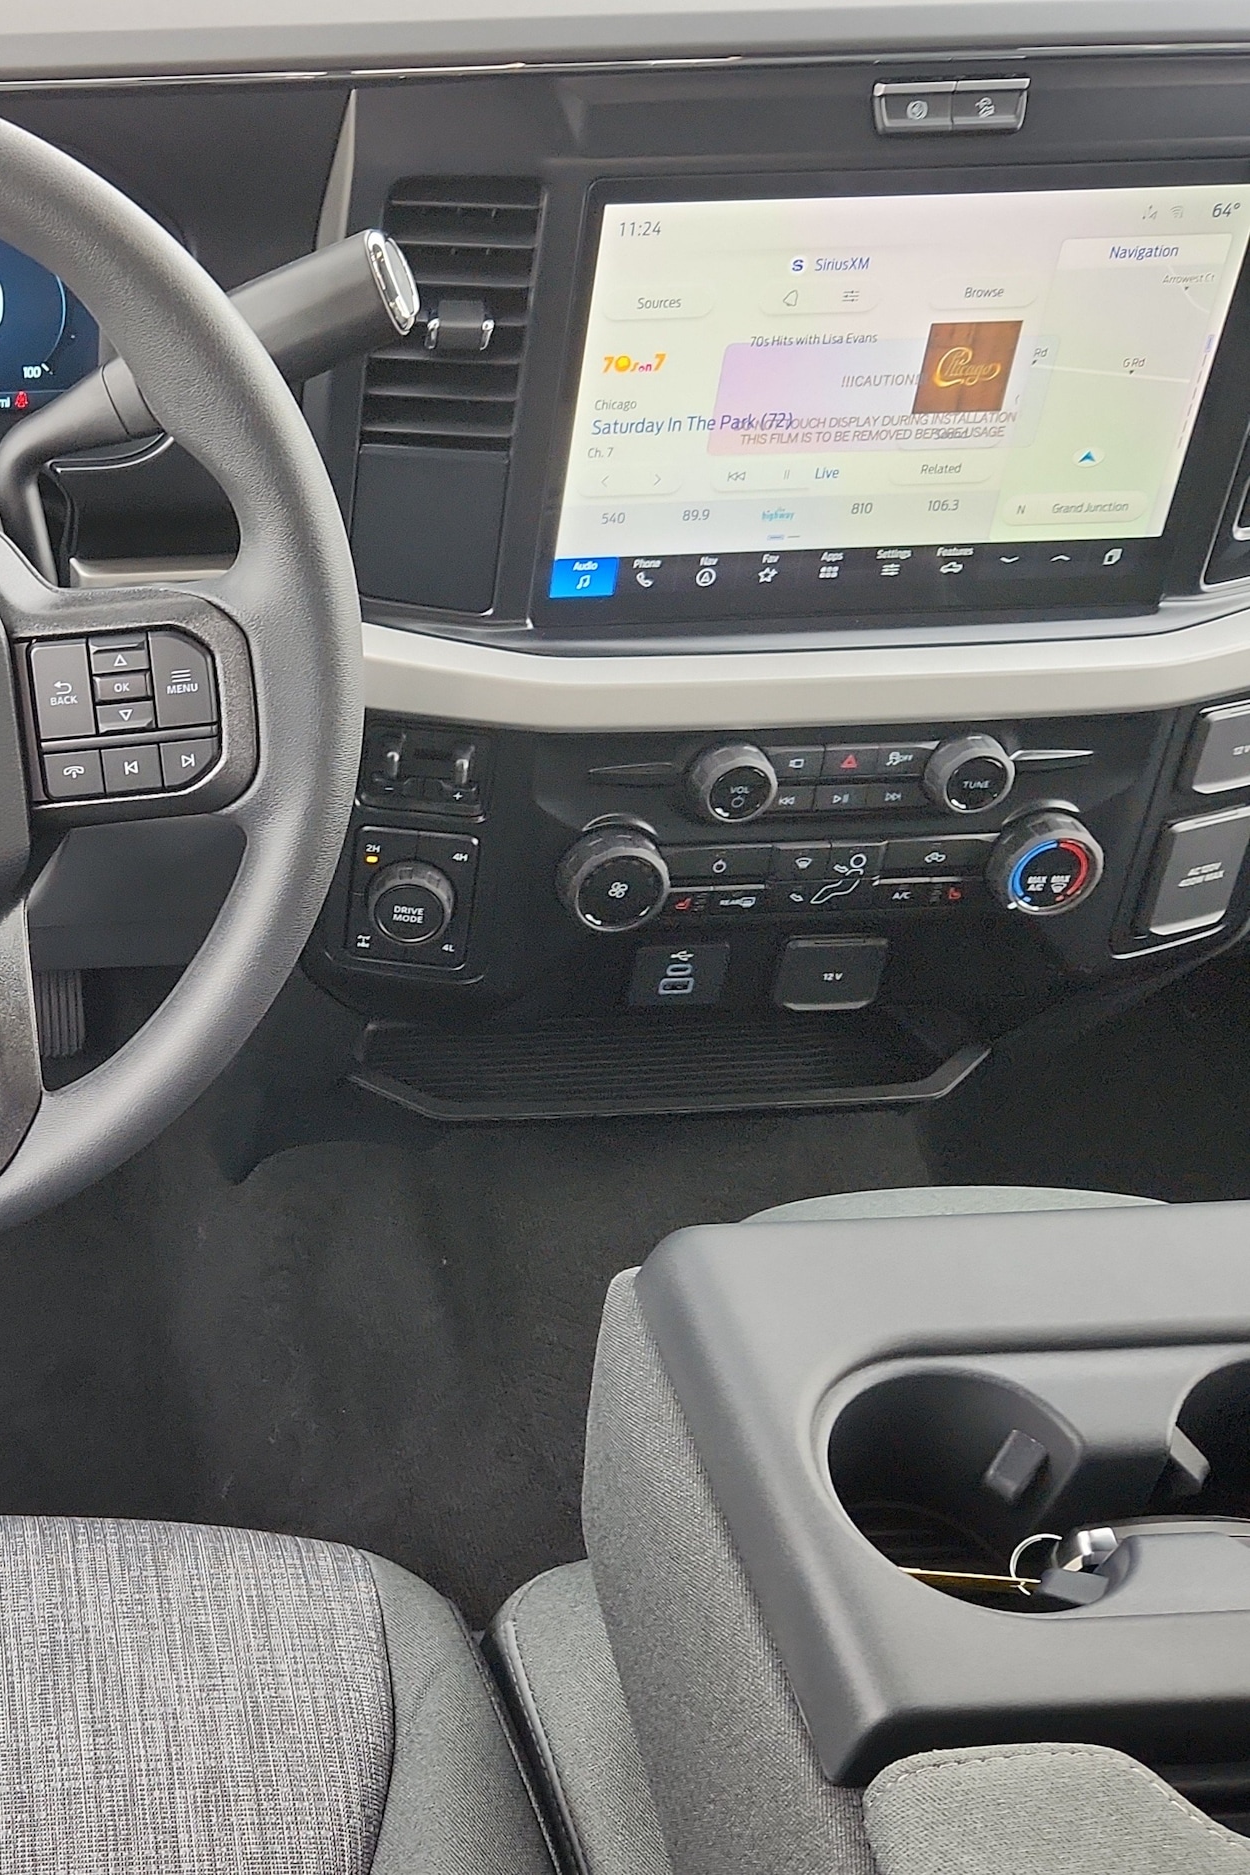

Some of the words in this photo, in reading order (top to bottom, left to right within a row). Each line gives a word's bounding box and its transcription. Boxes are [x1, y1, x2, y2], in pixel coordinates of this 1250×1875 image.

[1212, 202, 1241, 218] 64°
[618, 221, 662, 237] 11:24
[1109, 245, 1180, 260] Navigation
[814, 256, 871, 272] SiriusXM
[964, 287, 1004, 299] Browse
[637, 297, 682, 310] Sources
[750, 336, 770, 348] 70s
[771, 335, 794, 347] Hits
[795, 334, 820, 346] with
[822, 333, 844, 345] Lisa
[846, 332, 878, 344] Evans
[1033, 347, 1049, 358] Rd
[654, 353, 667, 372] 7
[933, 346, 1001, 388] Chicago
[1131, 357, 1146, 368] Rd
[23, 366, 42, 380] 100
[594, 398, 637, 412] Chicago
[591, 417, 664, 437] Saturday
[667, 416, 682, 432] In
[686, 415, 714, 432] The
[719, 413, 754, 430] Park
[760, 412, 793, 431] (72)
[829, 416, 880, 429] DISPLAY
[881, 413, 929, 427] DURING
[930, 411, 1017, 425] INSTALLATION
[740, 432, 768, 445] THIS
[769, 431, 800, 444] FILM
[800, 431, 813, 443] IS
[815, 430, 832, 443] TO
[833, 430, 851, 442] BE
[852, 428, 913, 442] REMOVED
[966, 425, 1007, 438] USAGE
[587, 447, 605, 459] Ch.
[606, 446, 615, 458] 7
[815, 467, 840, 480] Live
[920, 463, 962, 475] Related
[851, 502, 873, 515] 810
[927, 500, 960, 513] 106.3
[1016, 504, 1026, 515] N
[1052, 502, 1083, 514] Grand
[1084, 501, 1129, 514] Junction
[601, 512, 626, 525] 540
[681, 508, 710, 522] 89.9
[820, 551, 844, 562] Apps
[876, 548, 912, 560] Settings
[936, 546, 974, 558] Features
[572, 559, 599, 571] Audio
[633, 557, 662, 570] Phone
[699, 555, 719, 567] Nav
[761, 553, 780, 565] Fav
[113, 682, 130, 693] OK
[166, 683, 199, 695] MENU
[50, 695, 78, 706] BACK
[730, 786, 751, 795] VOL
[963, 780, 991, 790] TUNE
[365, 844, 381, 854] 2H
[452, 853, 469, 862] 4H
[892, 891, 911, 900] A/C
[393, 905, 424, 916] DRIVE
[392, 913, 424, 924] MODE
[441, 944, 455, 953] 4L
[822, 972, 835, 981] 12
[835, 972, 843, 981] V
